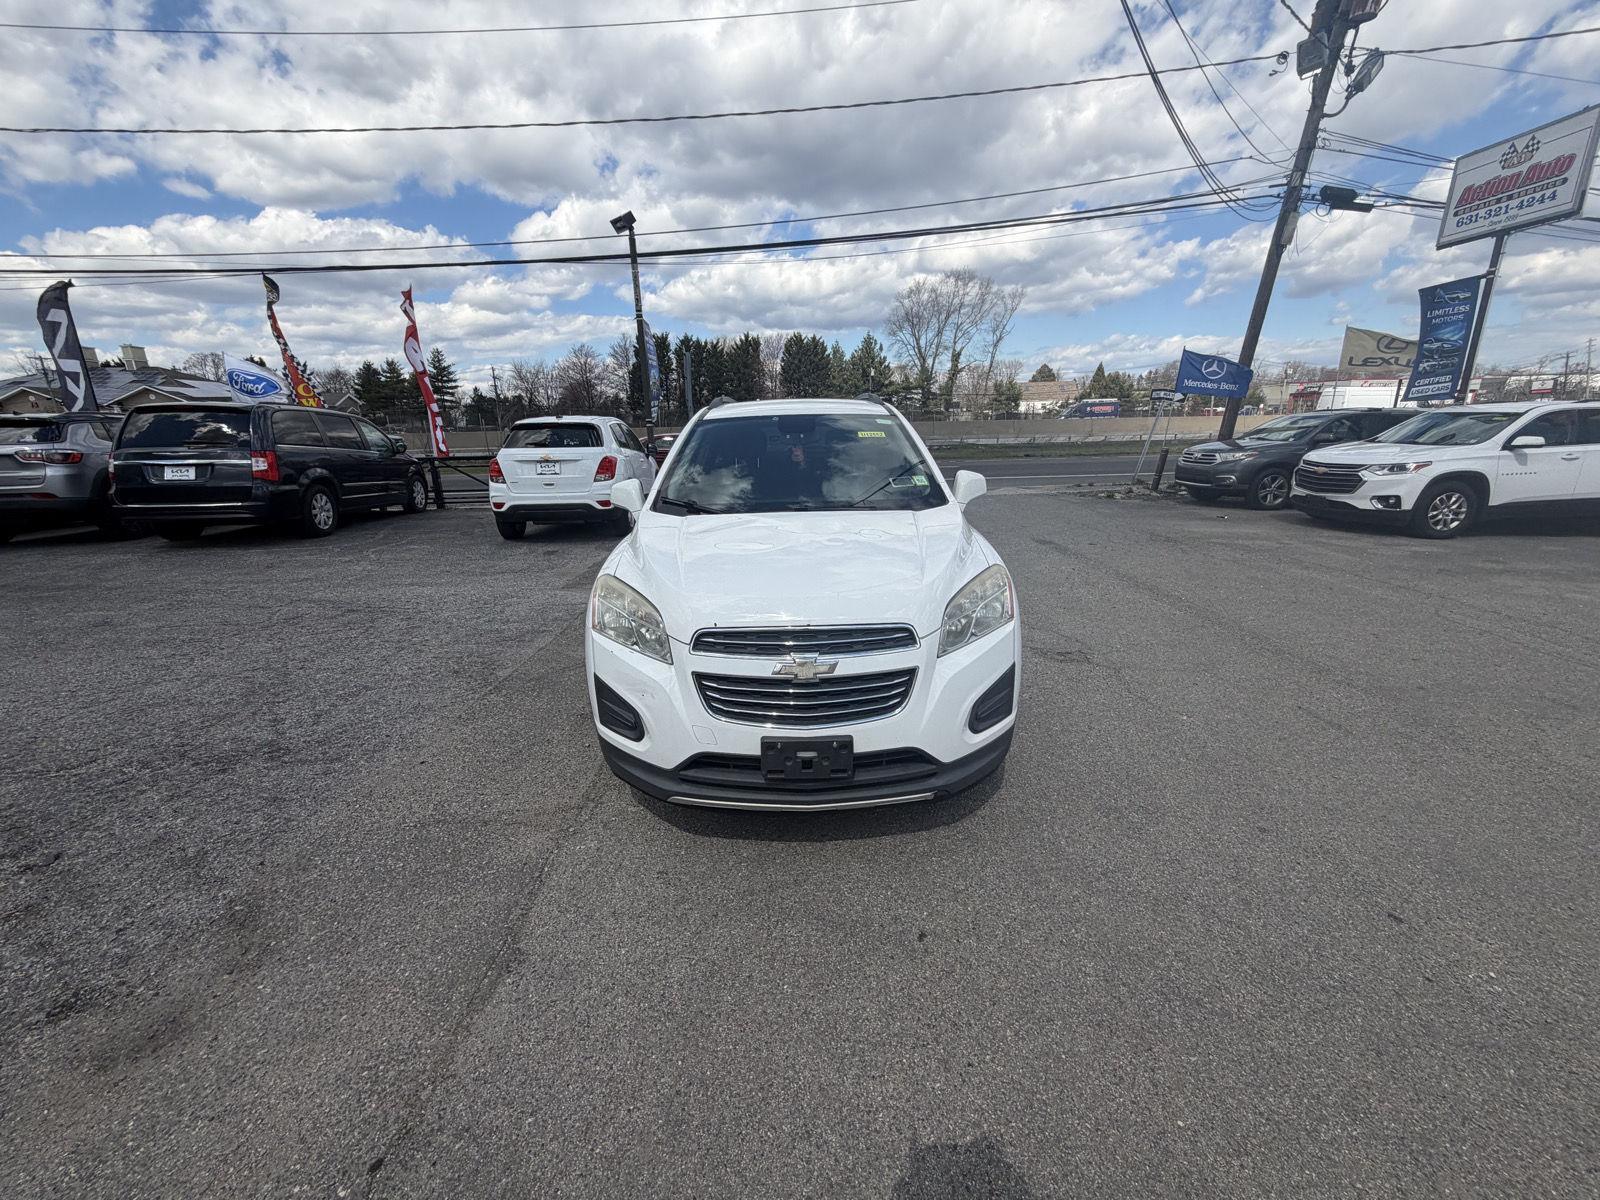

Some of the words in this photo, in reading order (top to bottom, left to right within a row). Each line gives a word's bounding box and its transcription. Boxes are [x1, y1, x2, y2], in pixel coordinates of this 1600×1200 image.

[1454, 171, 1523, 208] Action
[1518, 153, 1577, 190] Auto
[1456, 189, 1558, 228] 631-321-4244
[1427, 304, 1470, 318] LIMITLESS
[1431, 314, 1464, 325] MOTORS
[1348, 356, 1413, 368] LEXU
[232, 372, 267, 395] Ford
[1183, 379, 1240, 391] Mercedes-Benz
[1415, 375, 1452, 386] CERTIFIED
[1411, 388, 1429, 396] USED
[1431, 384, 1450, 392] CARS
